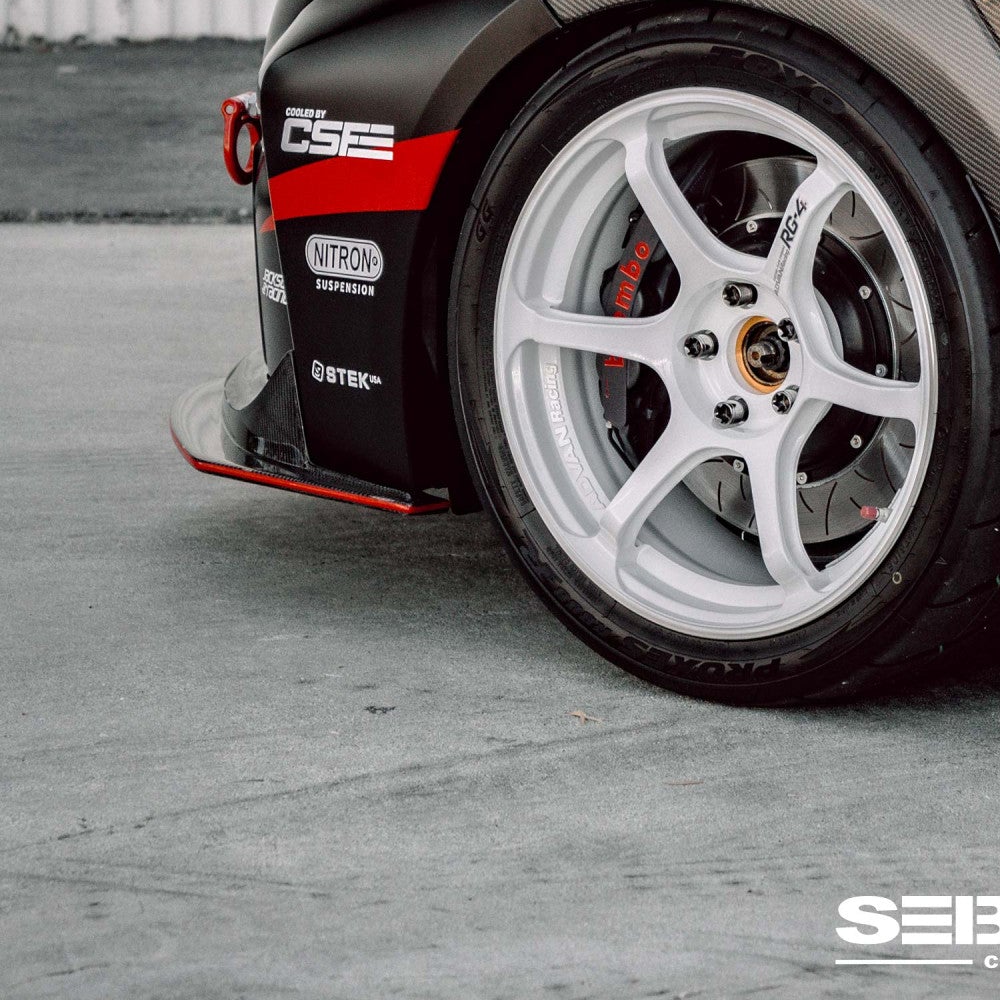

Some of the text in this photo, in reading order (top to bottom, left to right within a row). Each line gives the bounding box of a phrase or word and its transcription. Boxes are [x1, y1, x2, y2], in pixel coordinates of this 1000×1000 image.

[285, 107, 327, 119] COOLED BY
[281, 118, 395, 161] CSF
[315, 279, 375, 297] SUSPENSION
[325, 365, 382, 390] STEK USA
